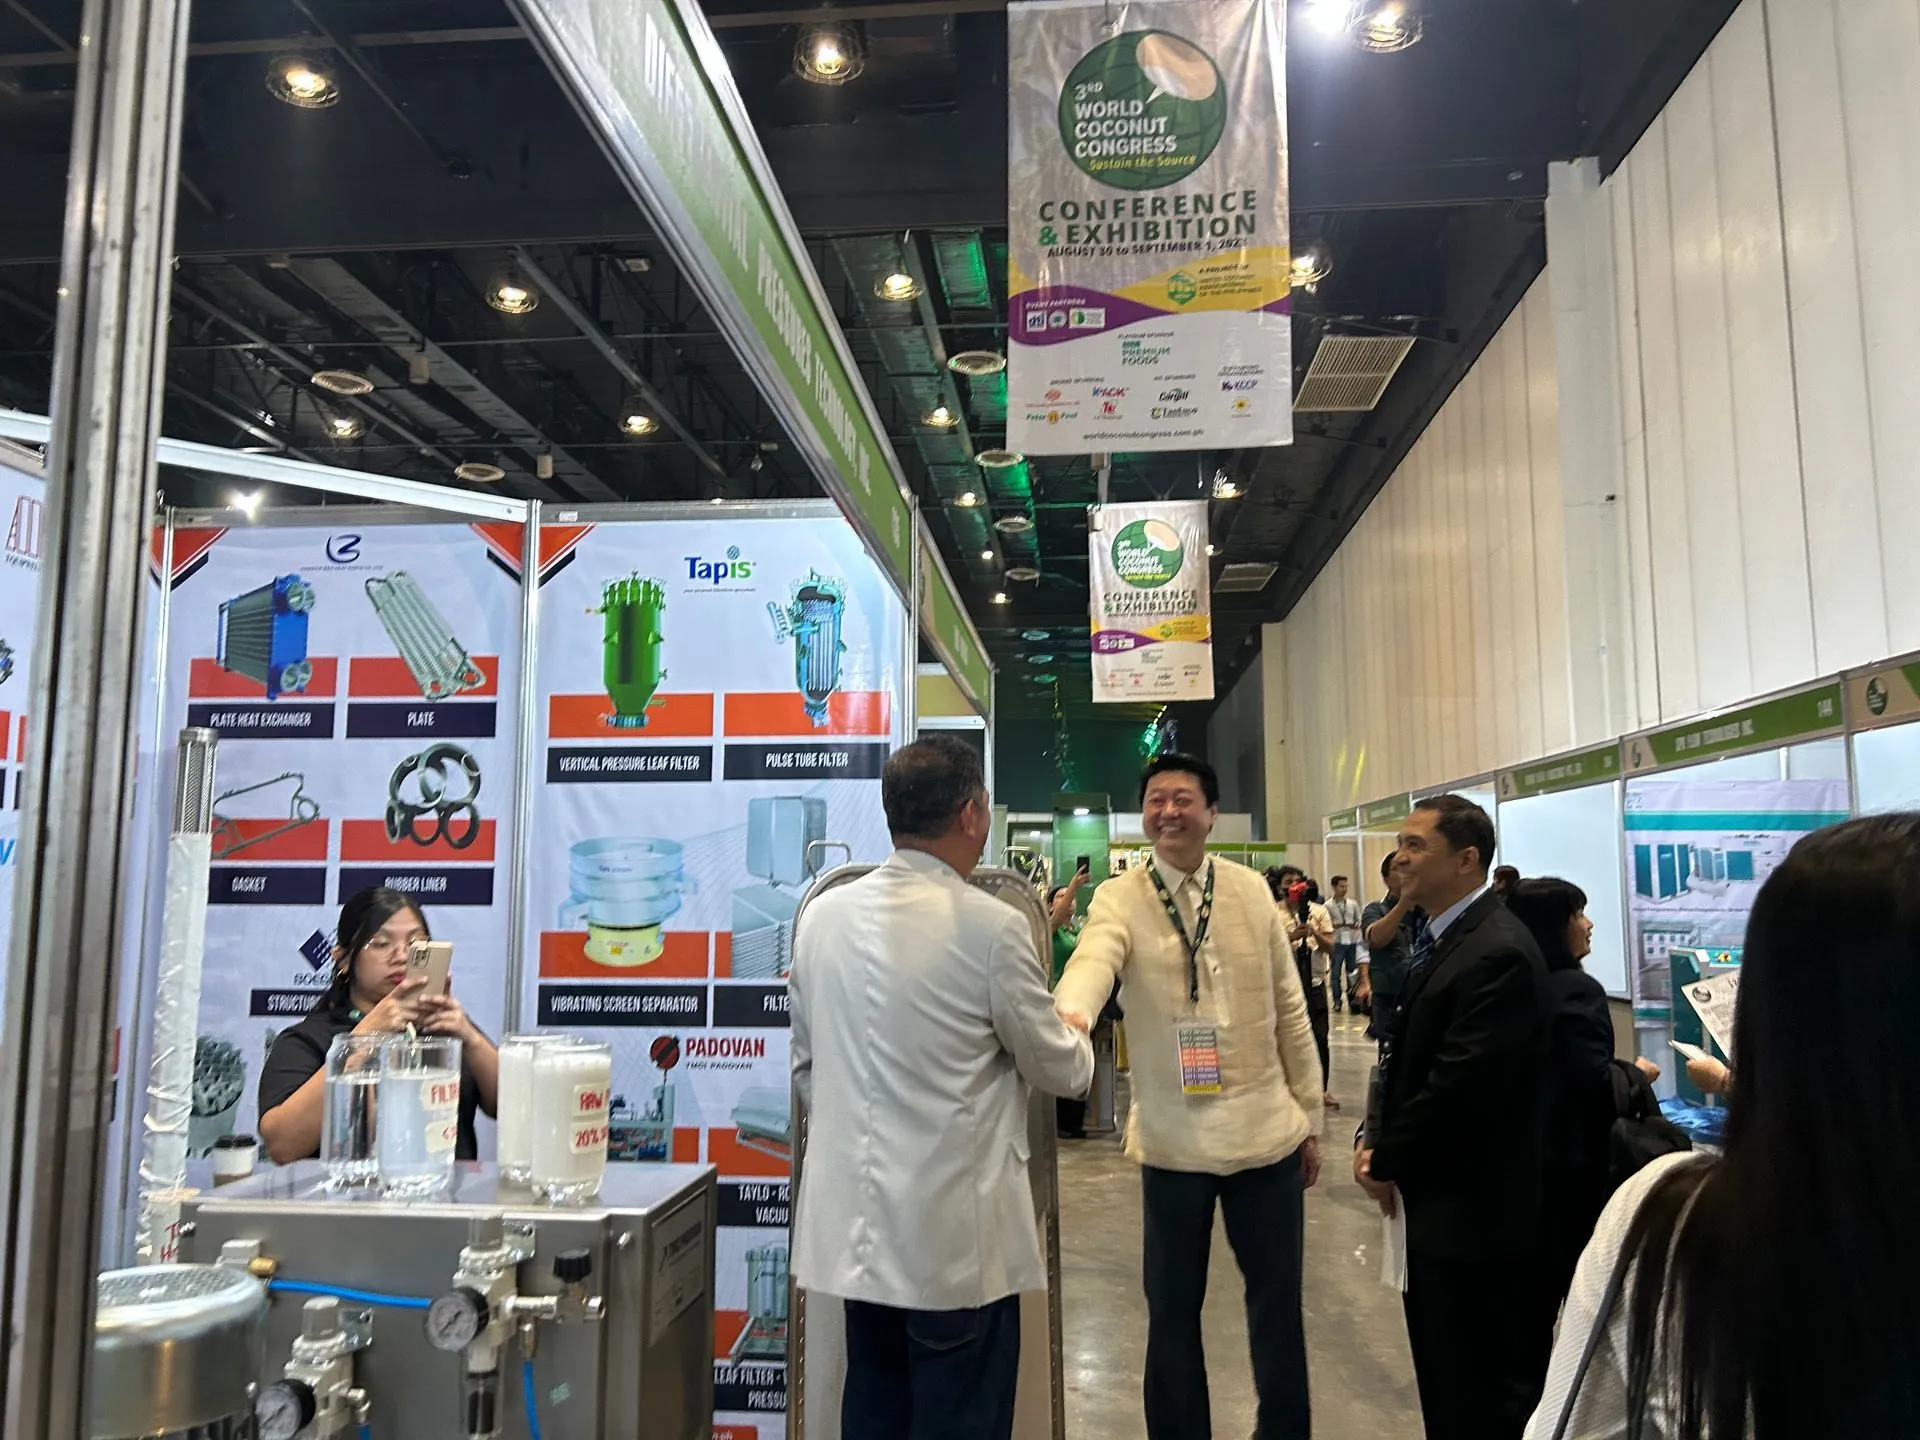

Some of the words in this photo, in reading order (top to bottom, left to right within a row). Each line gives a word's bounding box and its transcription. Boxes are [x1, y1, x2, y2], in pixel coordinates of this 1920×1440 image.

[1075, 101, 1143, 119] WORLD
[1074, 117, 1168, 139] COCONUT
[1074, 135, 1177, 158] CONGRESS
[1089, 157, 1132, 172] Sustain
[1135, 156, 1153, 169] the
[1157, 154, 1197, 168] Source
[1039, 190, 1256, 222] CONFERENCE
[1039, 226, 1058, 246] &
[1067, 214, 1255, 245] EXHIBITION
[1047, 246, 1095, 258] AUGUST
[1131, 239, 1202, 255] SEPTEMBER
[684, 545, 752, 585] Tapis
[1104, 589, 1198, 602] CONFERENCE
[1116, 600, 1197, 612] EXHIBITION
[210, 712, 237, 727] PLATE
[237, 712, 260, 727] HEAT
[260, 712, 312, 727] EXCHANGER
[408, 711, 435, 727] PLATE
[560, 756, 600, 772] VERTICAL
[601, 756, 646, 771] PRESSURE
[647, 756, 669, 771] LEAF
[670, 756, 700, 770] FILTER
[766, 752, 794, 768] PULSE
[795, 752, 817, 767] TUBE
[818, 752, 849, 767] FILTER
[231, 875, 267, 892] GASKET
[384, 876, 420, 892] RUBBER
[420, 876, 447, 892] LINER
[266, 994, 321, 1011] STRUCTUR
[551, 995, 602, 1012] VIBRATING
[603, 995, 640, 1012] SCREEN
[641, 995, 698, 1012] SEPARATOR
[763, 994, 790, 1011] FILTE
[685, 1037, 765, 1057] PADOVAN
[738, 1184, 769, 1201] TAYLO
[755, 1206, 789, 1224] VACUU
[714, 1367, 738, 1384] LEAF
[740, 1367, 774, 1386] FILTER
[748, 1390, 787, 1409] PRESSU
